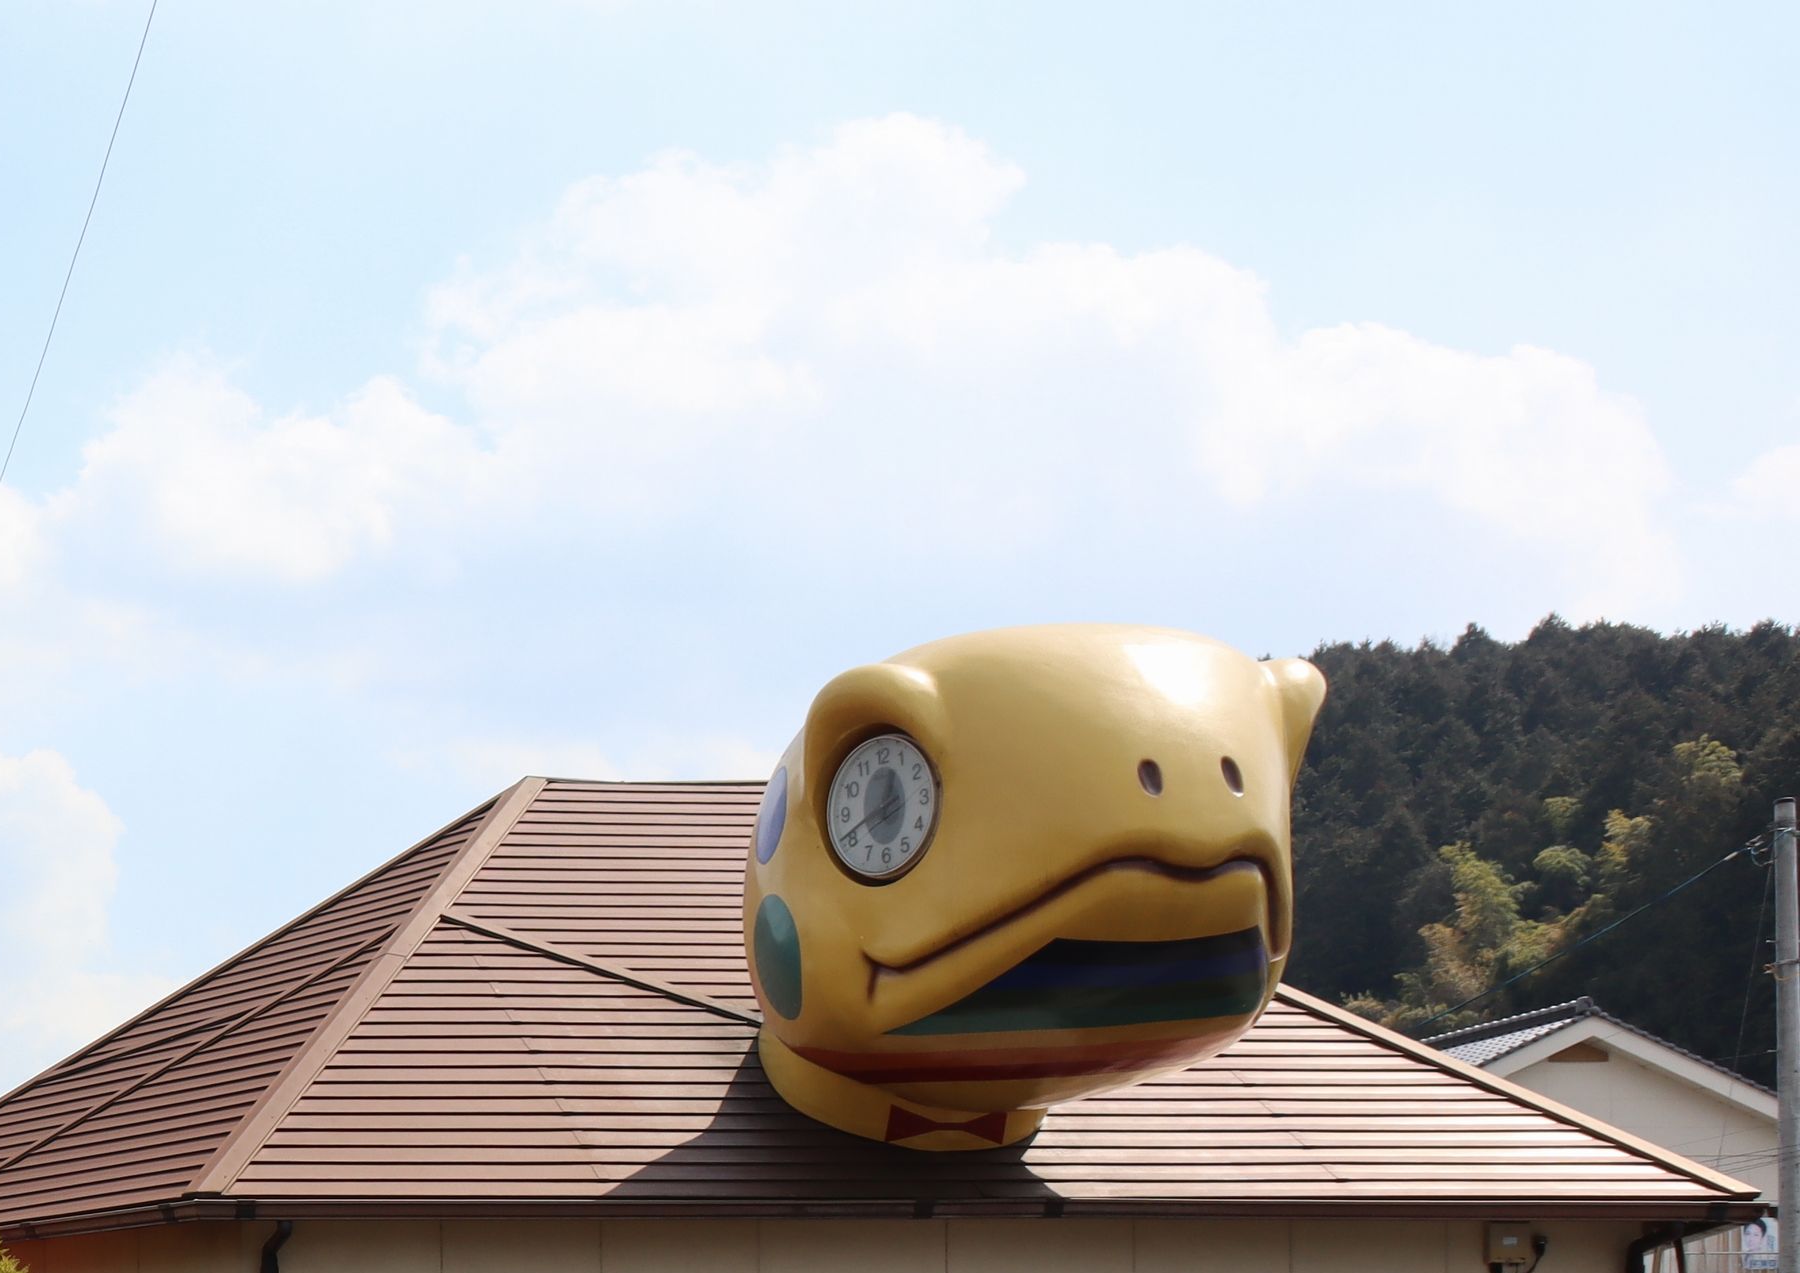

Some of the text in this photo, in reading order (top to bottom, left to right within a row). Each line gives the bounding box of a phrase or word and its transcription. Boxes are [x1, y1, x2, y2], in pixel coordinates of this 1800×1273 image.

[876, 748, 890, 765] 12
[898, 752, 904, 766] 1
[857, 761, 870, 777] 11
[912, 764, 922, 780] 2
[844, 781, 859, 798] 10
[920, 788, 929, 805] 3
[841, 807, 850, 823] 9
[914, 816, 924, 832] 4
[848, 831, 859, 848] 8
[901, 837, 910, 853] 5
[864, 845, 873, 861] 7
[882, 847, 891, 864] 6
